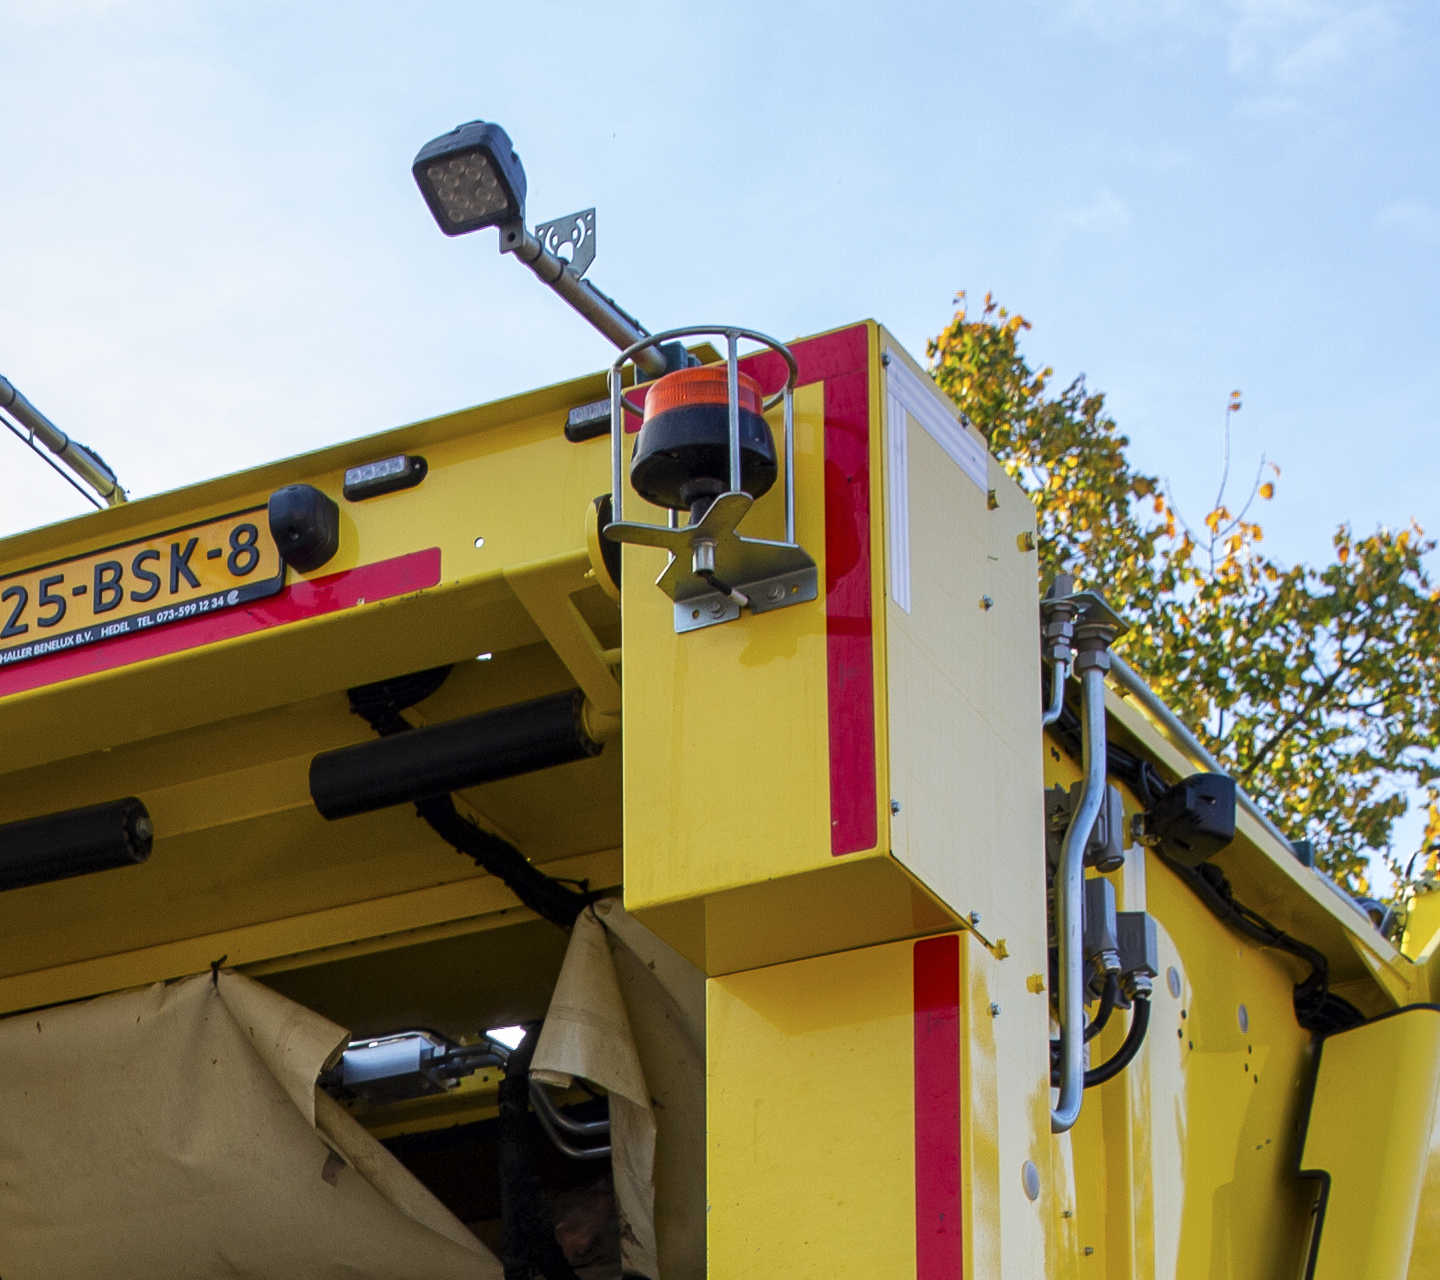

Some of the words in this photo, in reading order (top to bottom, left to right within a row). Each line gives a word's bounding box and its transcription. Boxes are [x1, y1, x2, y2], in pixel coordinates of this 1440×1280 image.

[0, 523, 260, 640] 25-BSK-8
[0, 647, 33, 663] HALLER
[34, 635, 74, 655] BENELUX
[75, 630, 94, 645] B.V.
[101, 621, 130, 637] HEDEL
[137, 617, 155, 628] TEL.
[156, 604, 197, 623] 073-599
[199, 600, 210, 611] 12
[211, 596, 224, 608] 34
